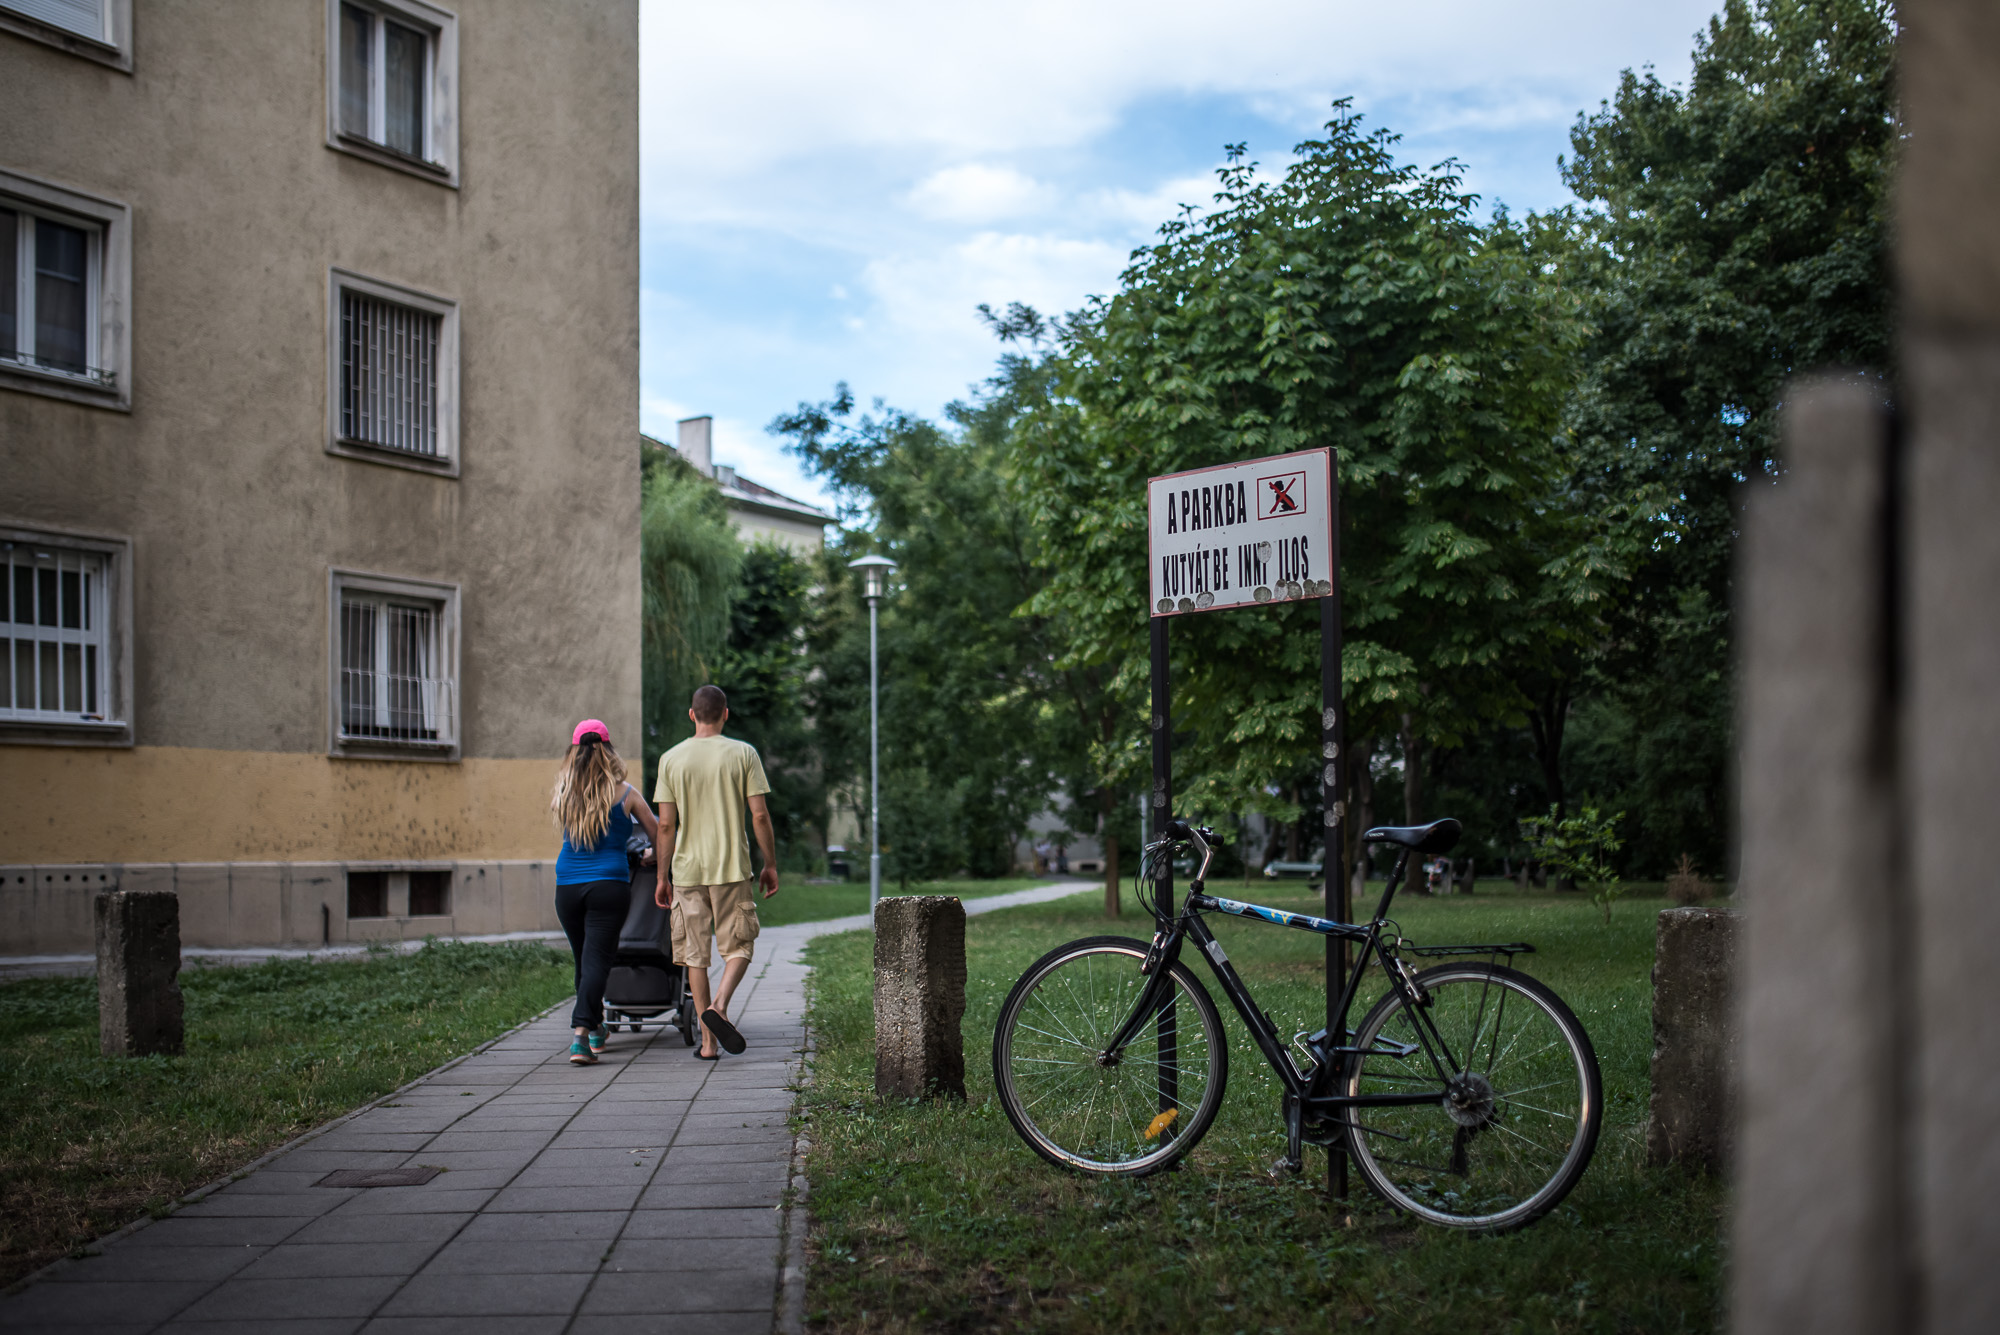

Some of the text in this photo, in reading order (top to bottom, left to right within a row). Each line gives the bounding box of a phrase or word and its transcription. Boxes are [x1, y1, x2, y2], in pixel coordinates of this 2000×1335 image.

[1168, 481, 1247, 534] A PARKBA
[1162, 543, 1210, 597] KUTYÁT
